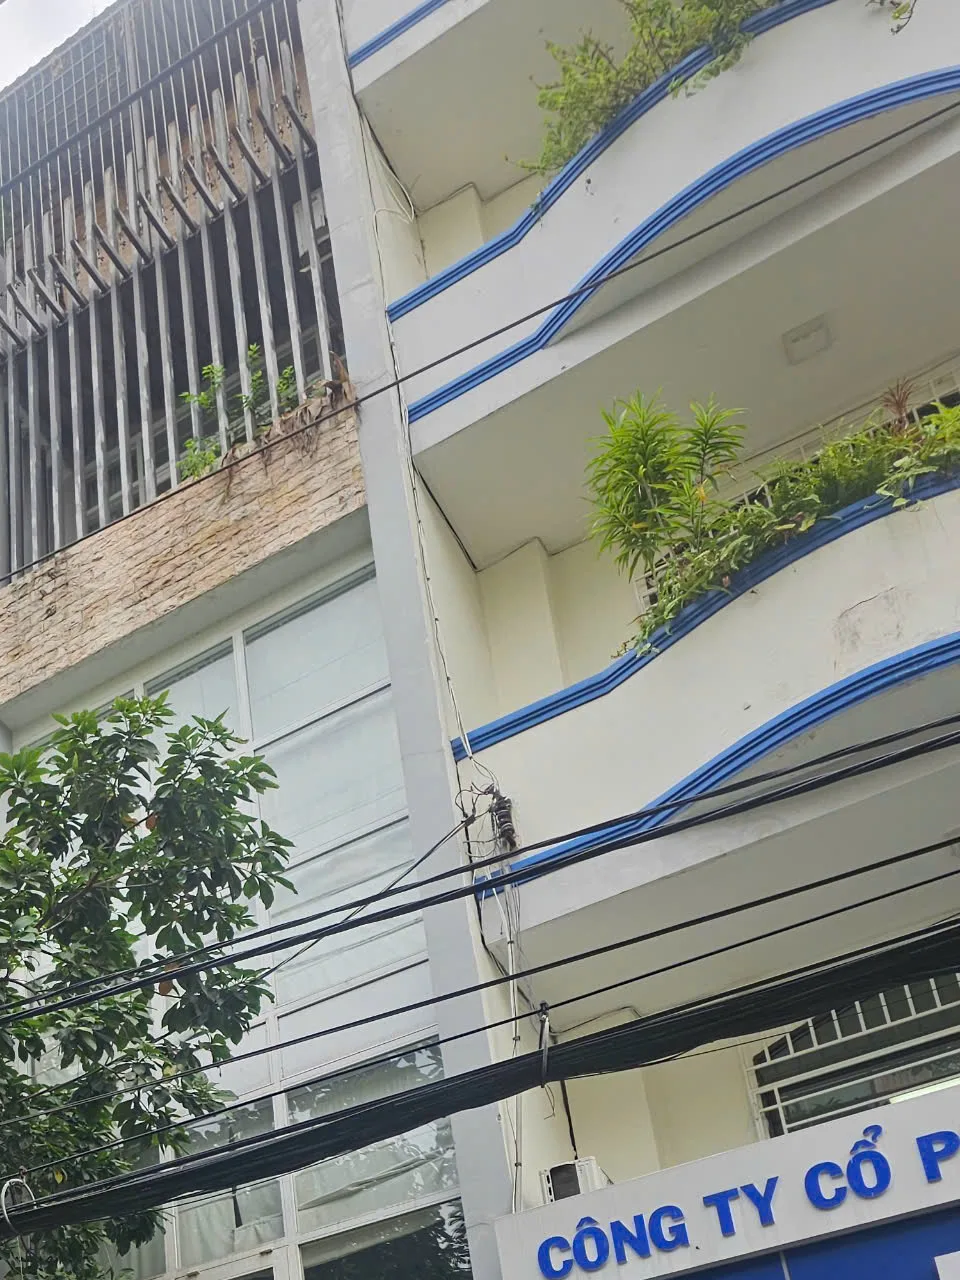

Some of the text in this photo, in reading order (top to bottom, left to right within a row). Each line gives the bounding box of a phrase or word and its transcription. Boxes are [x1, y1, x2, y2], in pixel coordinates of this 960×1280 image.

[537, 1205, 689, 1280] CÔNG
[703, 1176, 779, 1237] TY
[804, 1125, 892, 1210] CỔ
